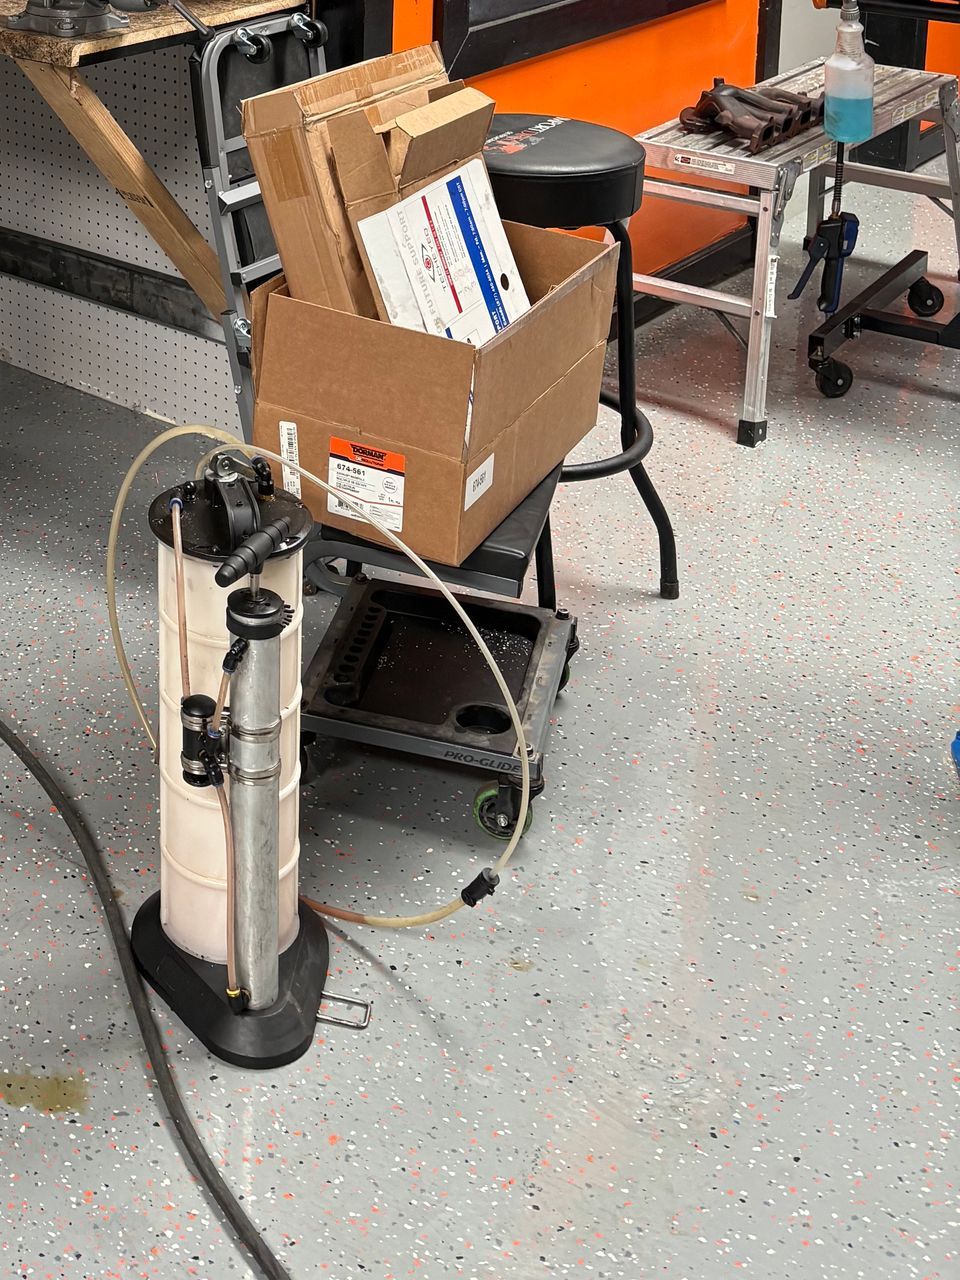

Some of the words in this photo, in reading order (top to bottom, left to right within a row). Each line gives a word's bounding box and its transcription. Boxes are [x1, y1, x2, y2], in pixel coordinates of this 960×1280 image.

[397, 210, 420, 266] SUPPORT
[417, 268, 436, 315] FUTURE
[336, 463, 366, 476] 674-561
[444, 750, 522, 772] PRO-GLIDE
